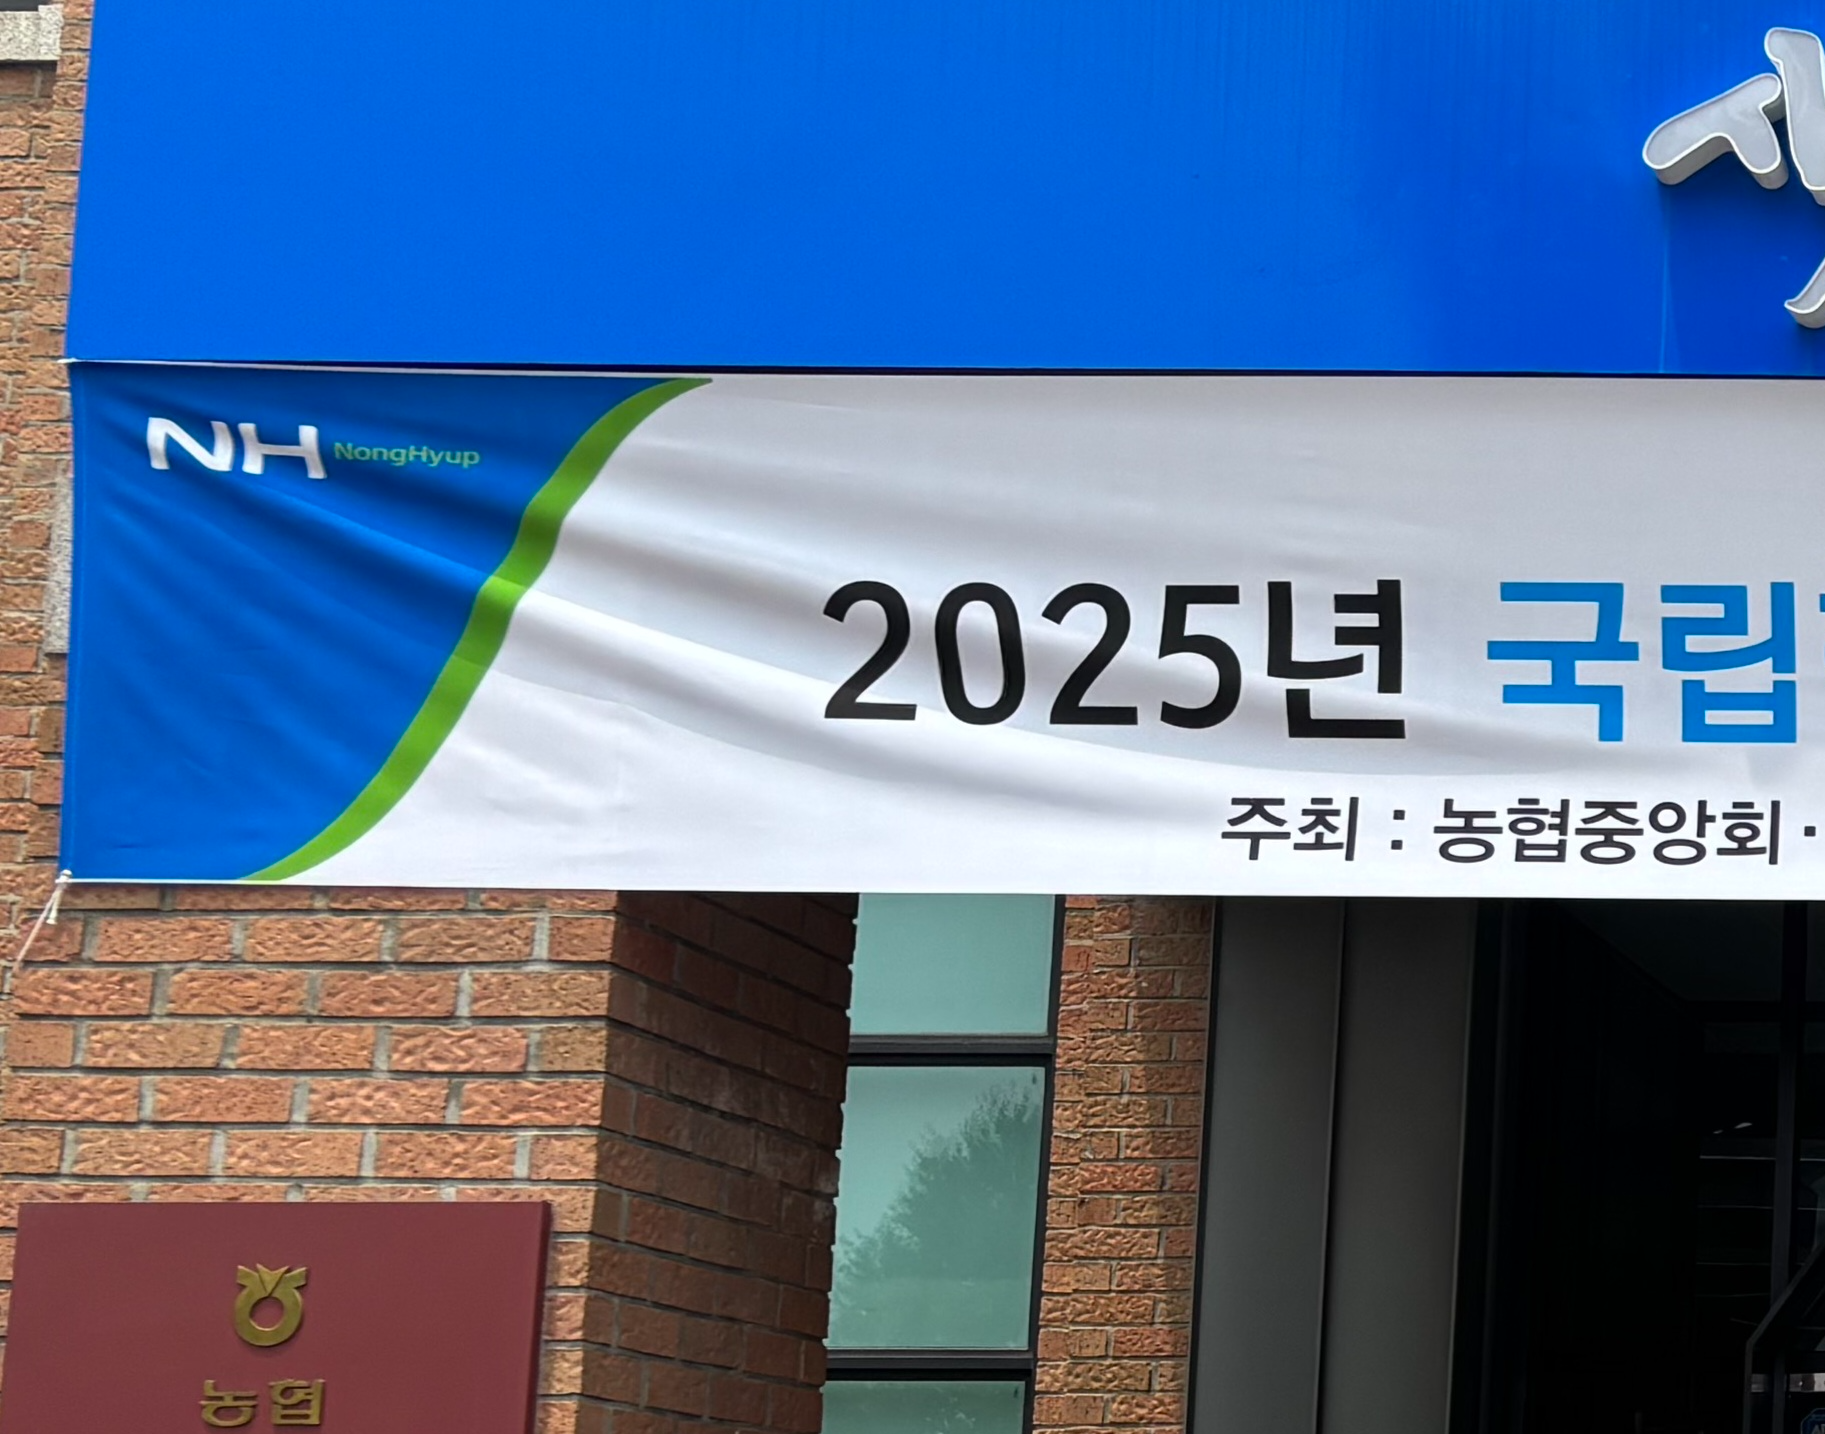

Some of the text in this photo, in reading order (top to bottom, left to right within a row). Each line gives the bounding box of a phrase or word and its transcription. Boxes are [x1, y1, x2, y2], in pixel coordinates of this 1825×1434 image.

[146, 416, 481, 479] NH NongHyup
[821, 576, 1407, 740] 2025년
[1219, 797, 1361, 863] 주최
[200, 1378, 326, 1428] 농협
